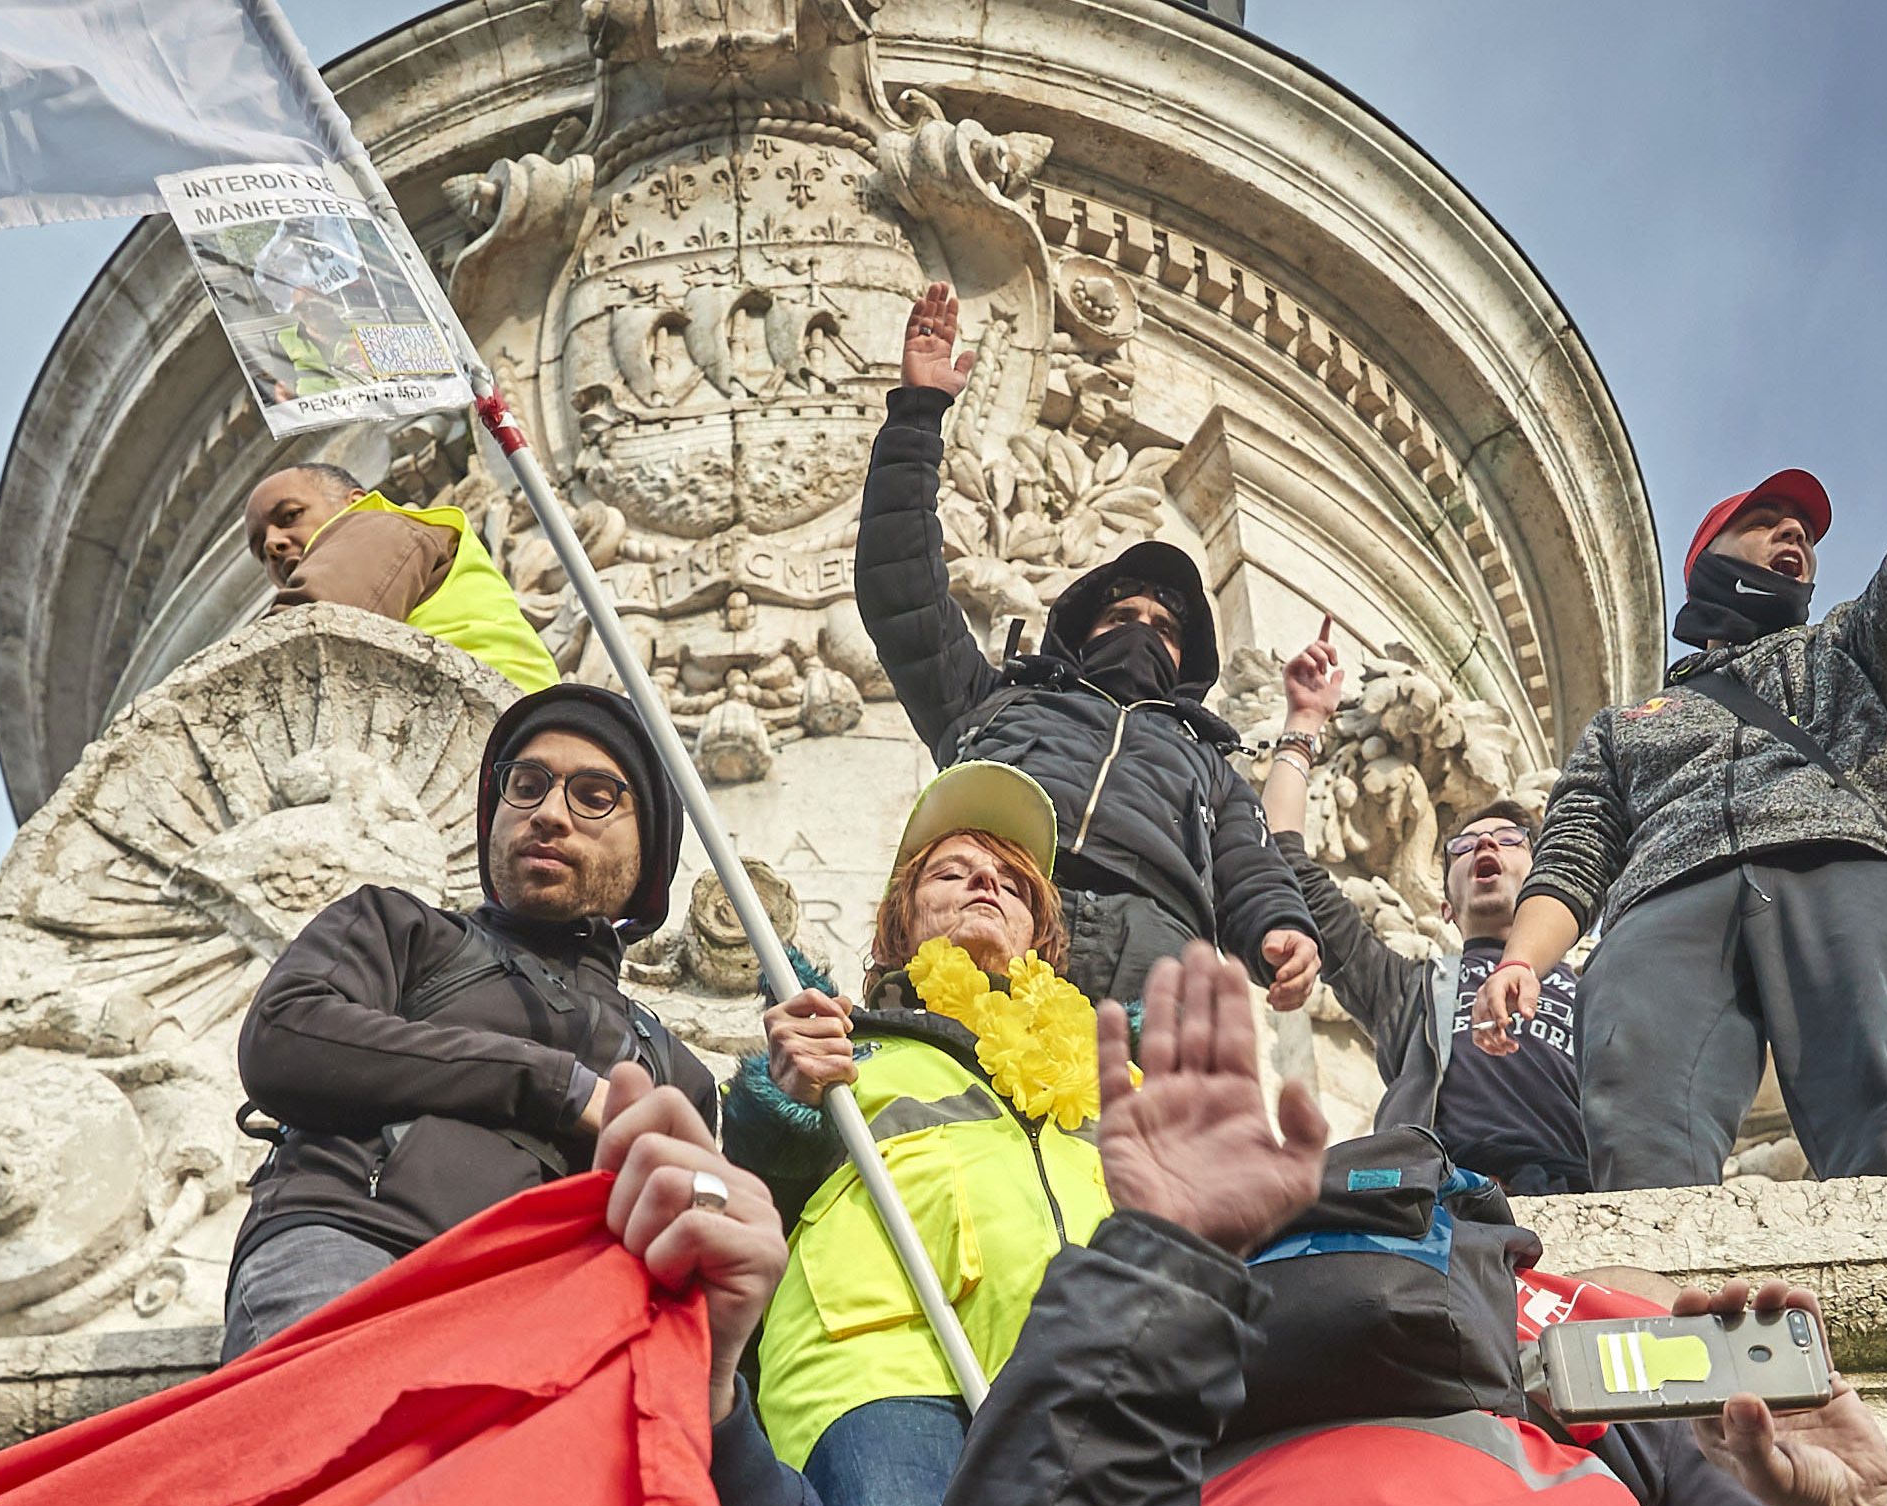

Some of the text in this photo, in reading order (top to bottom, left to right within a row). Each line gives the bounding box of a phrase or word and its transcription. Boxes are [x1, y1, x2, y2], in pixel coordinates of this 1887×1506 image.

[183, 173, 298, 199] INTERDIT
[194, 198, 355, 226] MANIFESTER
[397, 386, 437, 401] MOIS
